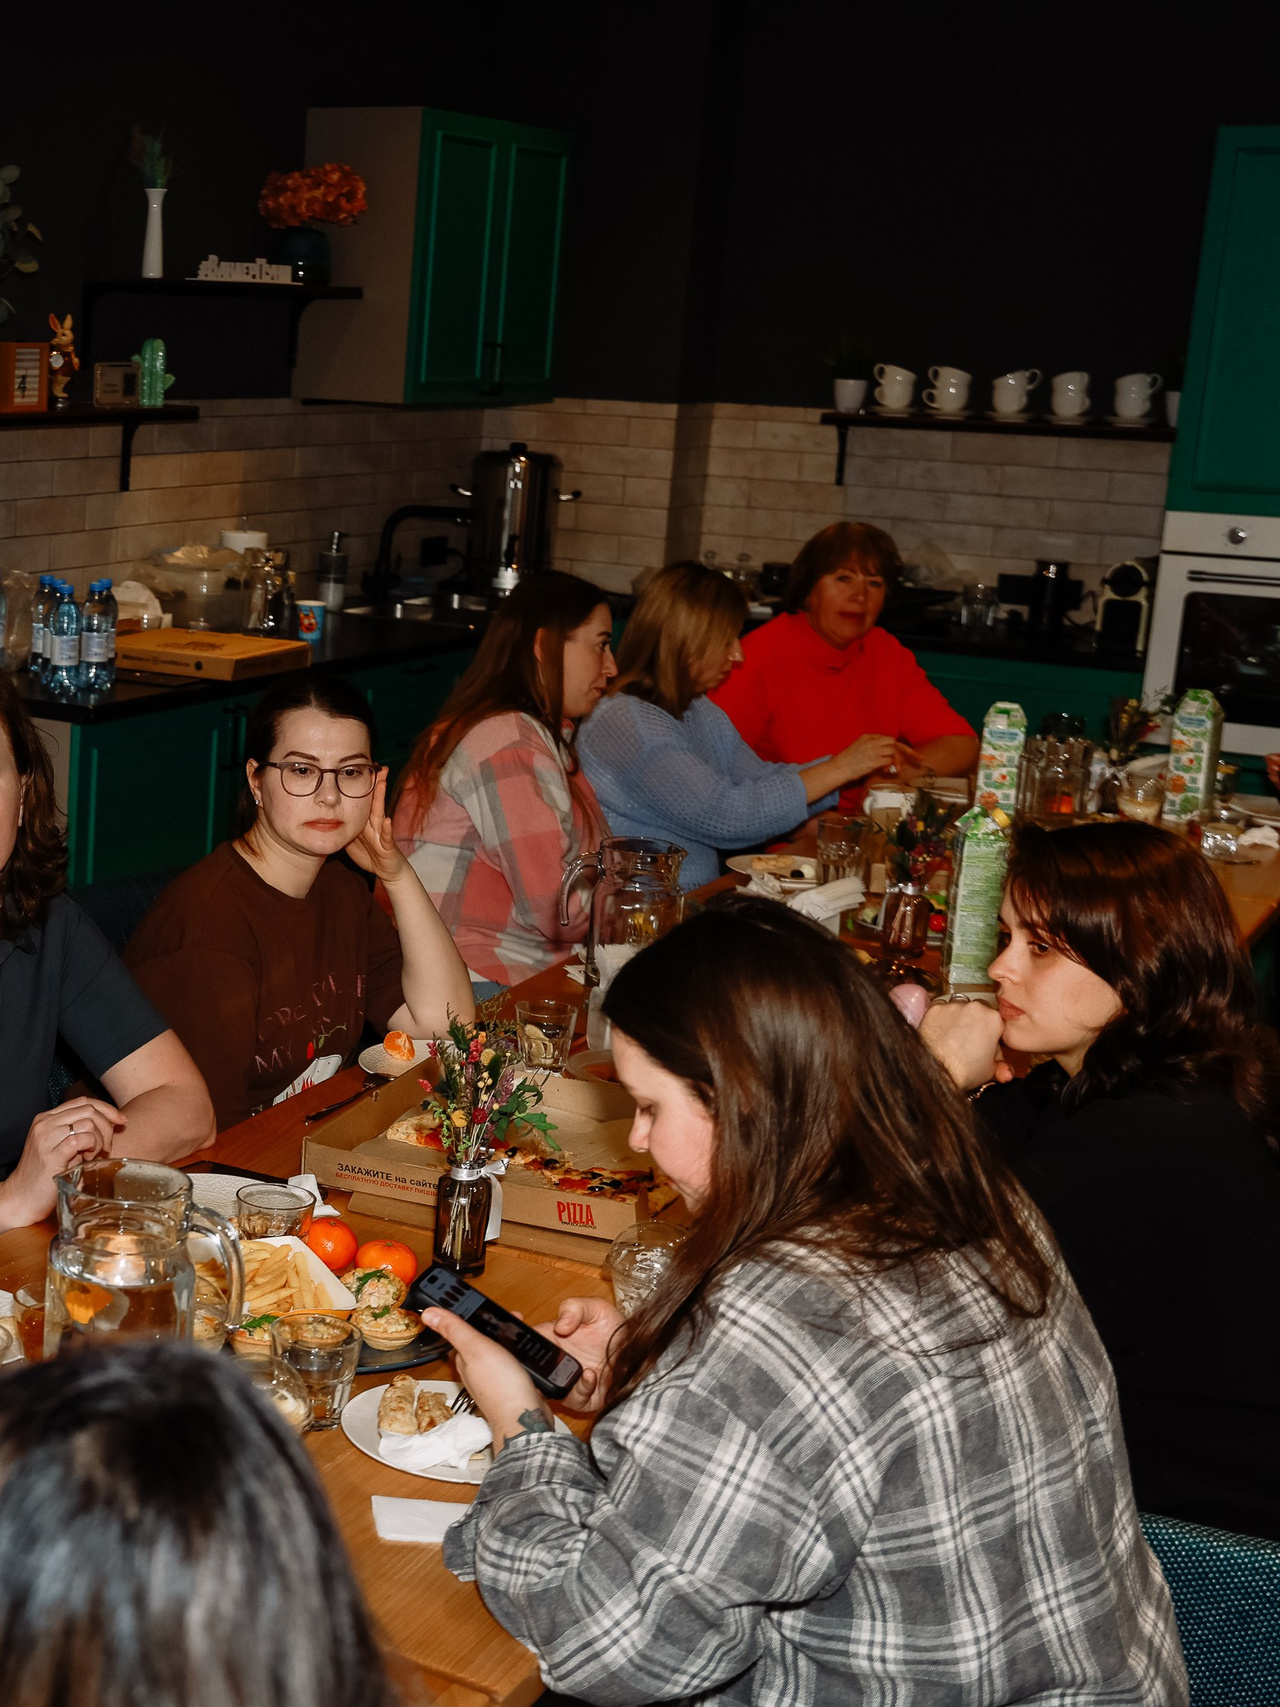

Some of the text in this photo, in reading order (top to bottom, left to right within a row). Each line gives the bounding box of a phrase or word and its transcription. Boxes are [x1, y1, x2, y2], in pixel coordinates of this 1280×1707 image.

[335, 1172, 379, 1186] БЕСПЛАТНУЮ
[380, 1180, 413, 1193] ДОСТАВКУ
[337, 1162, 438, 1190] ЗАКАЖИТЕ на сайте
[557, 1200, 595, 1227] PIZZA
